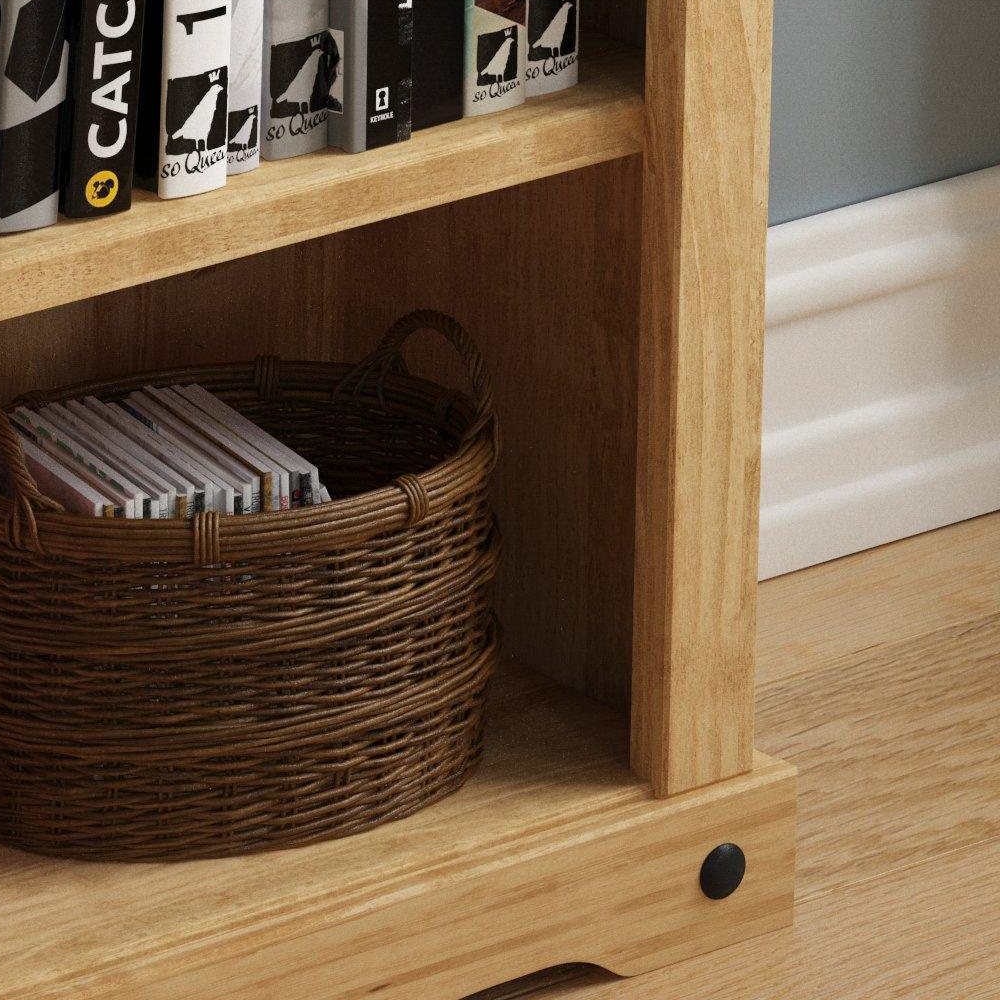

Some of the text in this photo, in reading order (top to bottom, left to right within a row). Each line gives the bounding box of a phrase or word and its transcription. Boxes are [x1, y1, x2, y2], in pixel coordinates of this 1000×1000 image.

[525, 66, 540, 81] so
[473, 80, 520, 103] so Queen
[370, 111, 394, 124] KEYHOLE
[266, 124, 285, 142] so
[160, 161, 180, 179] so
